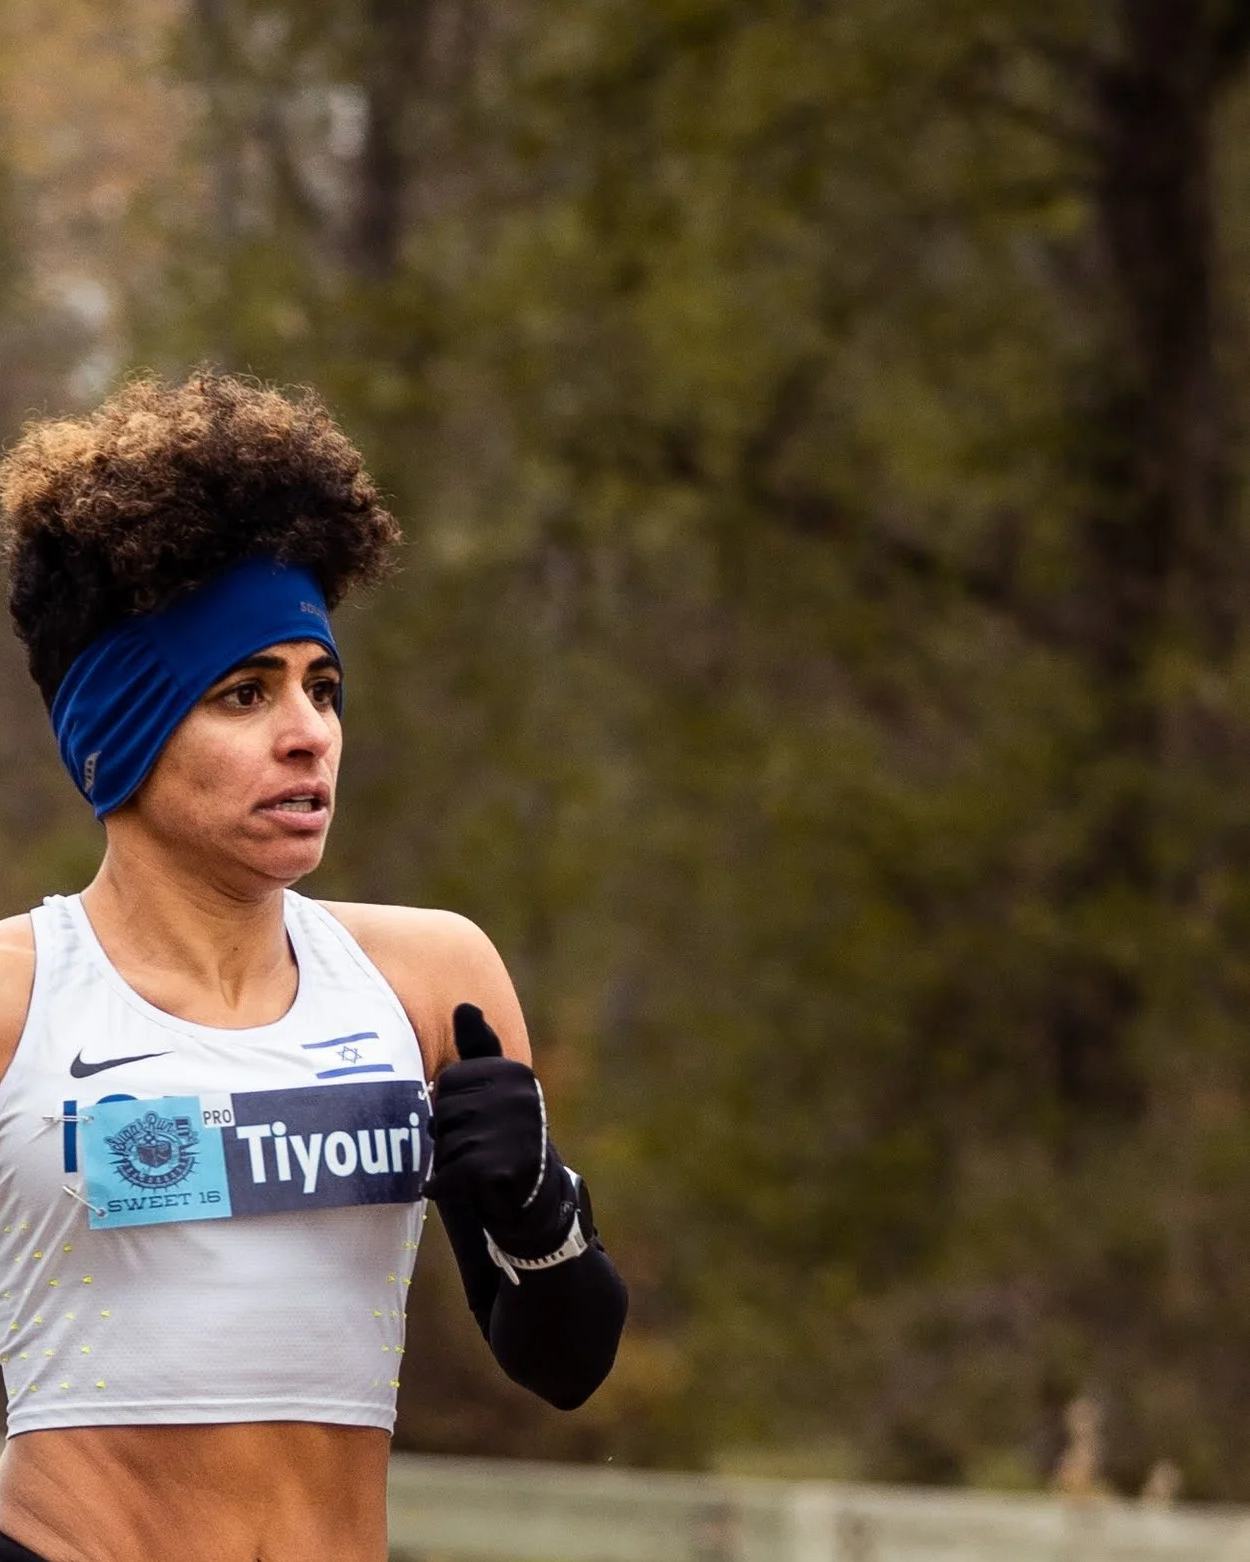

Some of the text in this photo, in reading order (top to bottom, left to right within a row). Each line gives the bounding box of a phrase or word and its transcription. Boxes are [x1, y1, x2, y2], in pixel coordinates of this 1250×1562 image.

[202, 1109, 233, 1125] PRO
[236, 1112, 422, 1194] Tiyouri
[107, 1190, 221, 1213] SWEET 16
